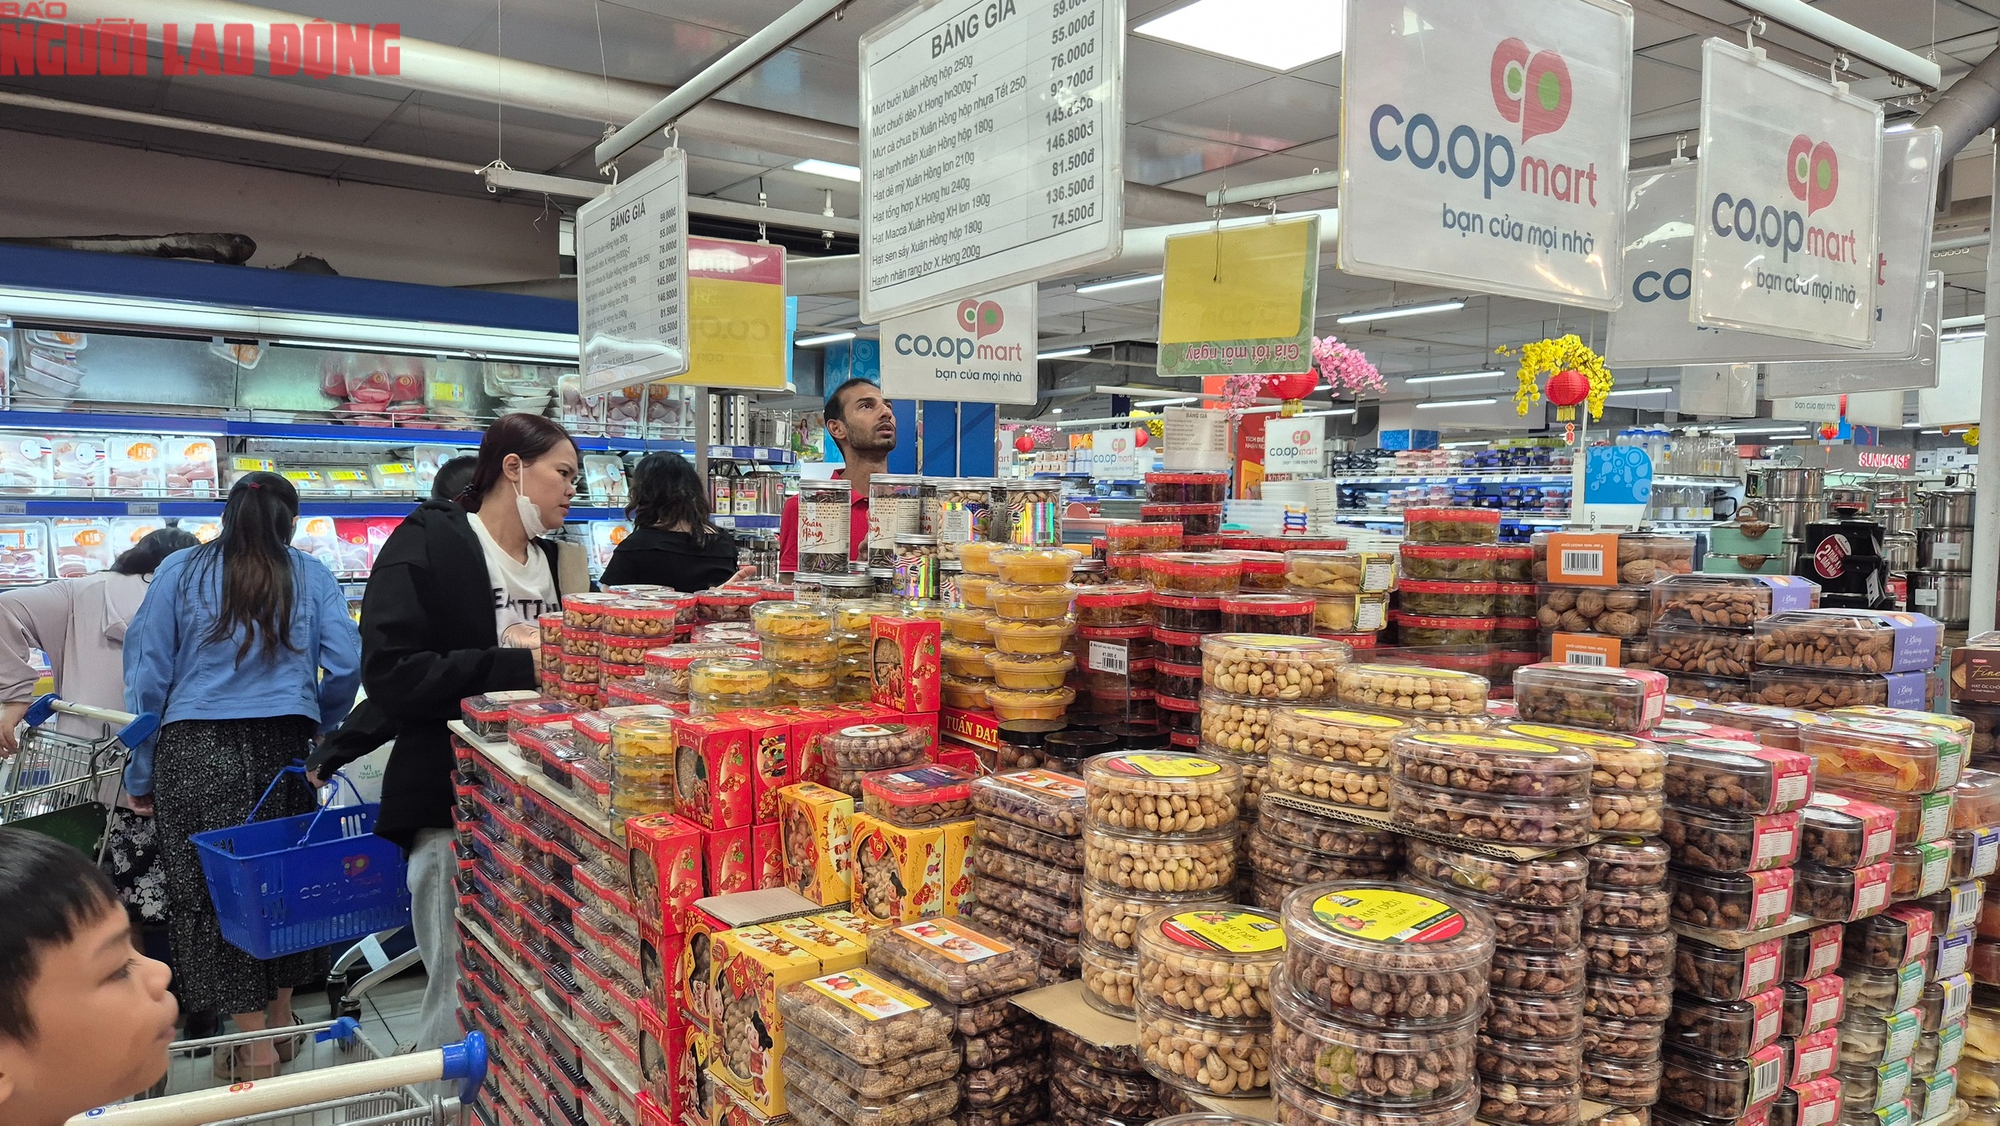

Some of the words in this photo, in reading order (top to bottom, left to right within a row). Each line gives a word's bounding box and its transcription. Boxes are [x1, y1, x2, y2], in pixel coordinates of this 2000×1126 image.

[1053, 0, 1088, 18] 59.0
[931, 13, 979, 60] BẢNG
[1052, 10, 1095, 45] 55.000đ
[1051, 37, 1095, 71] 76.000đ
[902, 85, 918, 101] Xuân
[919, 74, 937, 91] Hồng
[939, 66, 952, 80] hộp
[954, 55, 973, 73] 250g
[1051, 65, 1094, 97] 92700đ
[896, 134, 912, 150] chua
[919, 120, 937, 138] Xuân
[938, 112, 957, 128] Hồng
[958, 104, 973, 119] hộp
[973, 93, 994, 110] nhựa
[995, 82, 1008, 99] Tết
[1010, 75, 1026, 93] 250
[918, 94, 943, 117] X.Hong
[872, 169, 885, 182] Hạt
[902, 152, 918, 168] nhân
[919, 143, 936, 161] Xuân
[937, 136, 956, 152] Hồng
[958, 128, 972, 143] hộp
[974, 118, 994, 135] 180g
[1047, 120, 1094, 152] 146.800đ
[905, 173, 922, 189] Xuân
[923, 166, 941, 181] Hồng
[943, 161, 954, 174] lon
[955, 151, 974, 168] 210g
[1053, 147, 1095, 177] 81.500đ
[873, 212, 885, 224] Hạt
[915, 189, 939, 208] X.Hong
[951, 177, 970, 193] 240g
[1046, 175, 1095, 205] 136.500đ
[610, 209, 631, 232] BẢNG
[632, 198, 646, 221] GIÁ
[872, 233, 884, 245] Hạt
[885, 226, 907, 241] Macca
[908, 218, 925, 233] Xuân
[926, 211, 945, 226] Hồng
[946, 204, 957, 219] XH
[959, 201, 970, 214] lon
[972, 193, 991, 208] 190g
[1052, 202, 1095, 229] 74.500đ
[1442, 203, 1484, 238] bạn
[1489, 213, 1523, 243] của
[1528, 225, 1557, 254] mọi
[1562, 230, 1595, 256] nhà
[660, 223, 677, 239] 55.000đ
[872, 255, 884, 267] Hạt
[885, 251, 897, 262] sen
[910, 239, 928, 254] Xuân
[929, 233, 948, 246] Hồng
[949, 227, 963, 242] hộp
[964, 220, 983, 235] 180g
[659, 239, 677, 254] 76.000đ
[907, 265, 922, 277] rang
[934, 251, 960, 269] X.Hong
[962, 244, 981, 260] 200g
[659, 256, 677, 270] 92.700đ
[657, 272, 677, 287] 145.800đ
[1756, 267, 1782, 297] bạn
[1812, 281, 1834, 307] mọi
[1835, 281, 1857, 305] nhà
[660, 304, 677, 318] 81.500đ
[659, 320, 677, 335] 136.500đ
[1186, 343, 1218, 364] ngày
[1221, 344, 1248, 366] mỗi
[1251, 344, 1271, 365] tốt
[1274, 344, 1300, 361] Giá
[935, 367, 958, 382] bạn
[959, 368, 981, 382] của
[983, 370, 1000, 384] mọi
[1002, 371, 1022, 383] nhà
[1860, 452, 1909, 469] SUNHOUSE
[801, 517, 823, 529] Xuân
[945, 714, 973, 736] TUẤN
[975, 724, 998, 744] ĐẠT
